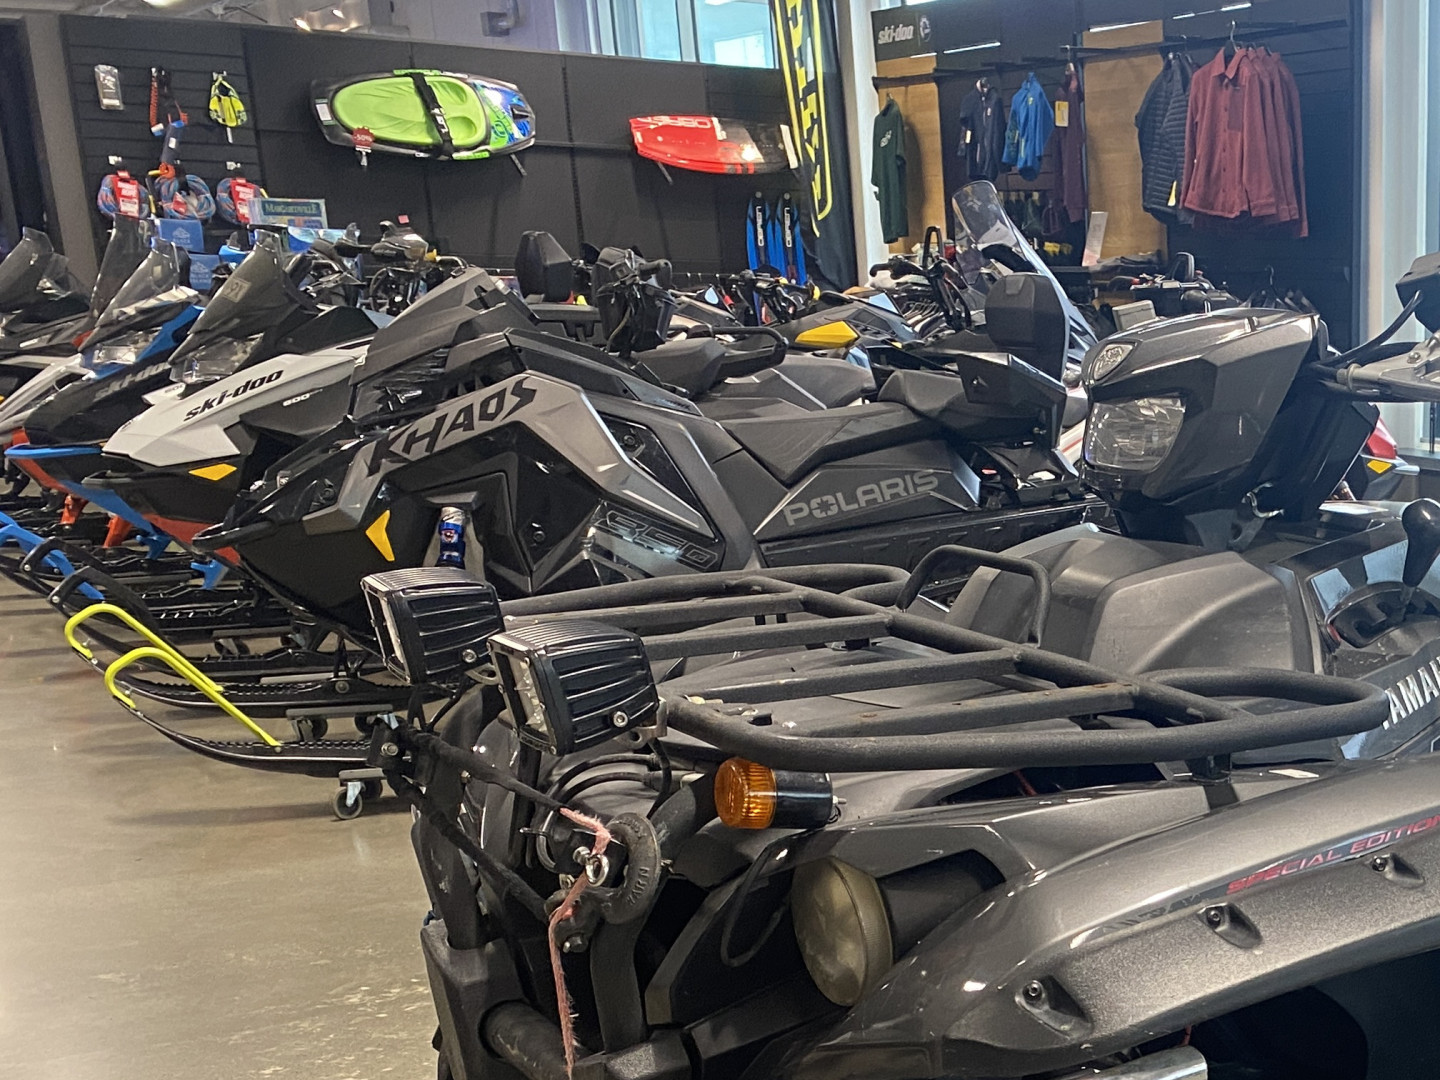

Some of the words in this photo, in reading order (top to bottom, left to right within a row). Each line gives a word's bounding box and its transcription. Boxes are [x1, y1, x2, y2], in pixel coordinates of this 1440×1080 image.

[877, 23, 914, 45] ski-doo
[183, 369, 285, 422] ski-doo
[364, 375, 538, 478] KHAOS
[782, 471, 940, 527] POLARIS
[1225, 849, 1342, 896] SPECIAL
